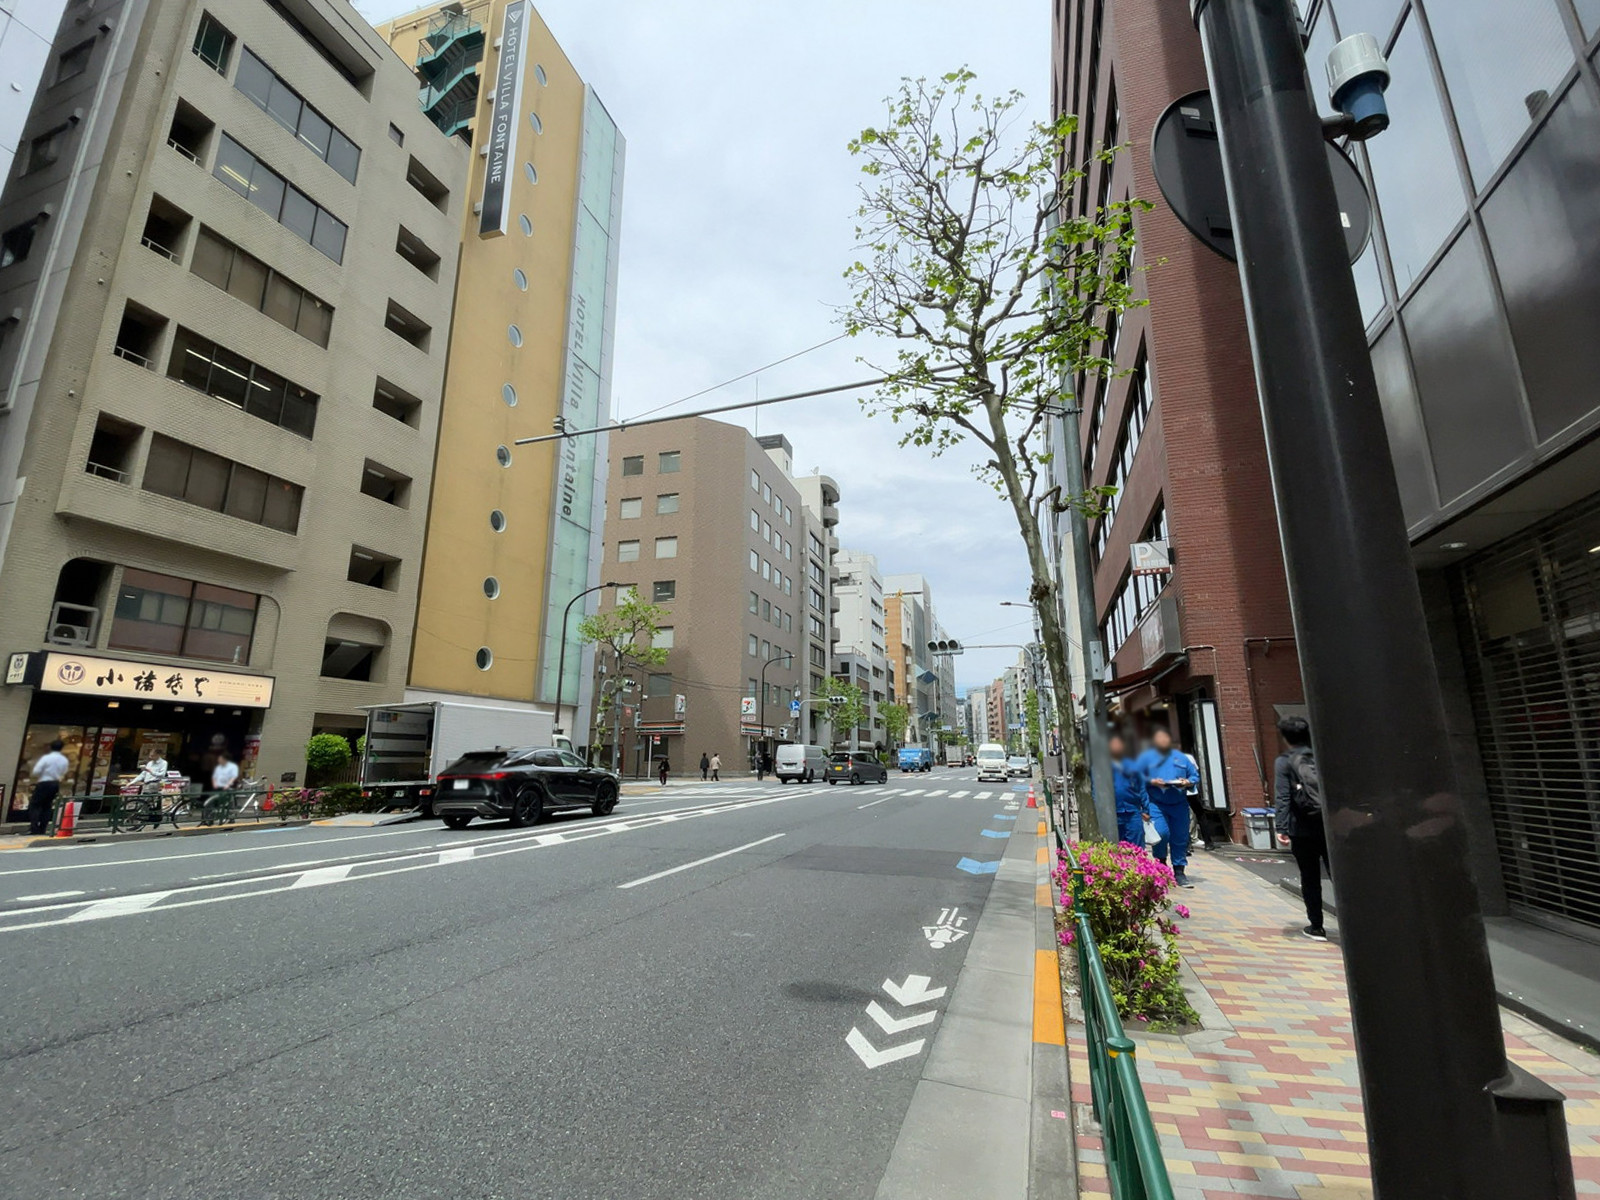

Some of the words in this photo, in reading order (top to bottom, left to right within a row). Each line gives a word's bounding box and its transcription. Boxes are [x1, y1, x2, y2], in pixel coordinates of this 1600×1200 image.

[505, 27, 518, 70] HOTEL
[500, 72, 513, 110] VILLA
[491, 114, 508, 184] FONTAINE
[574, 294, 586, 350] HOTEL
